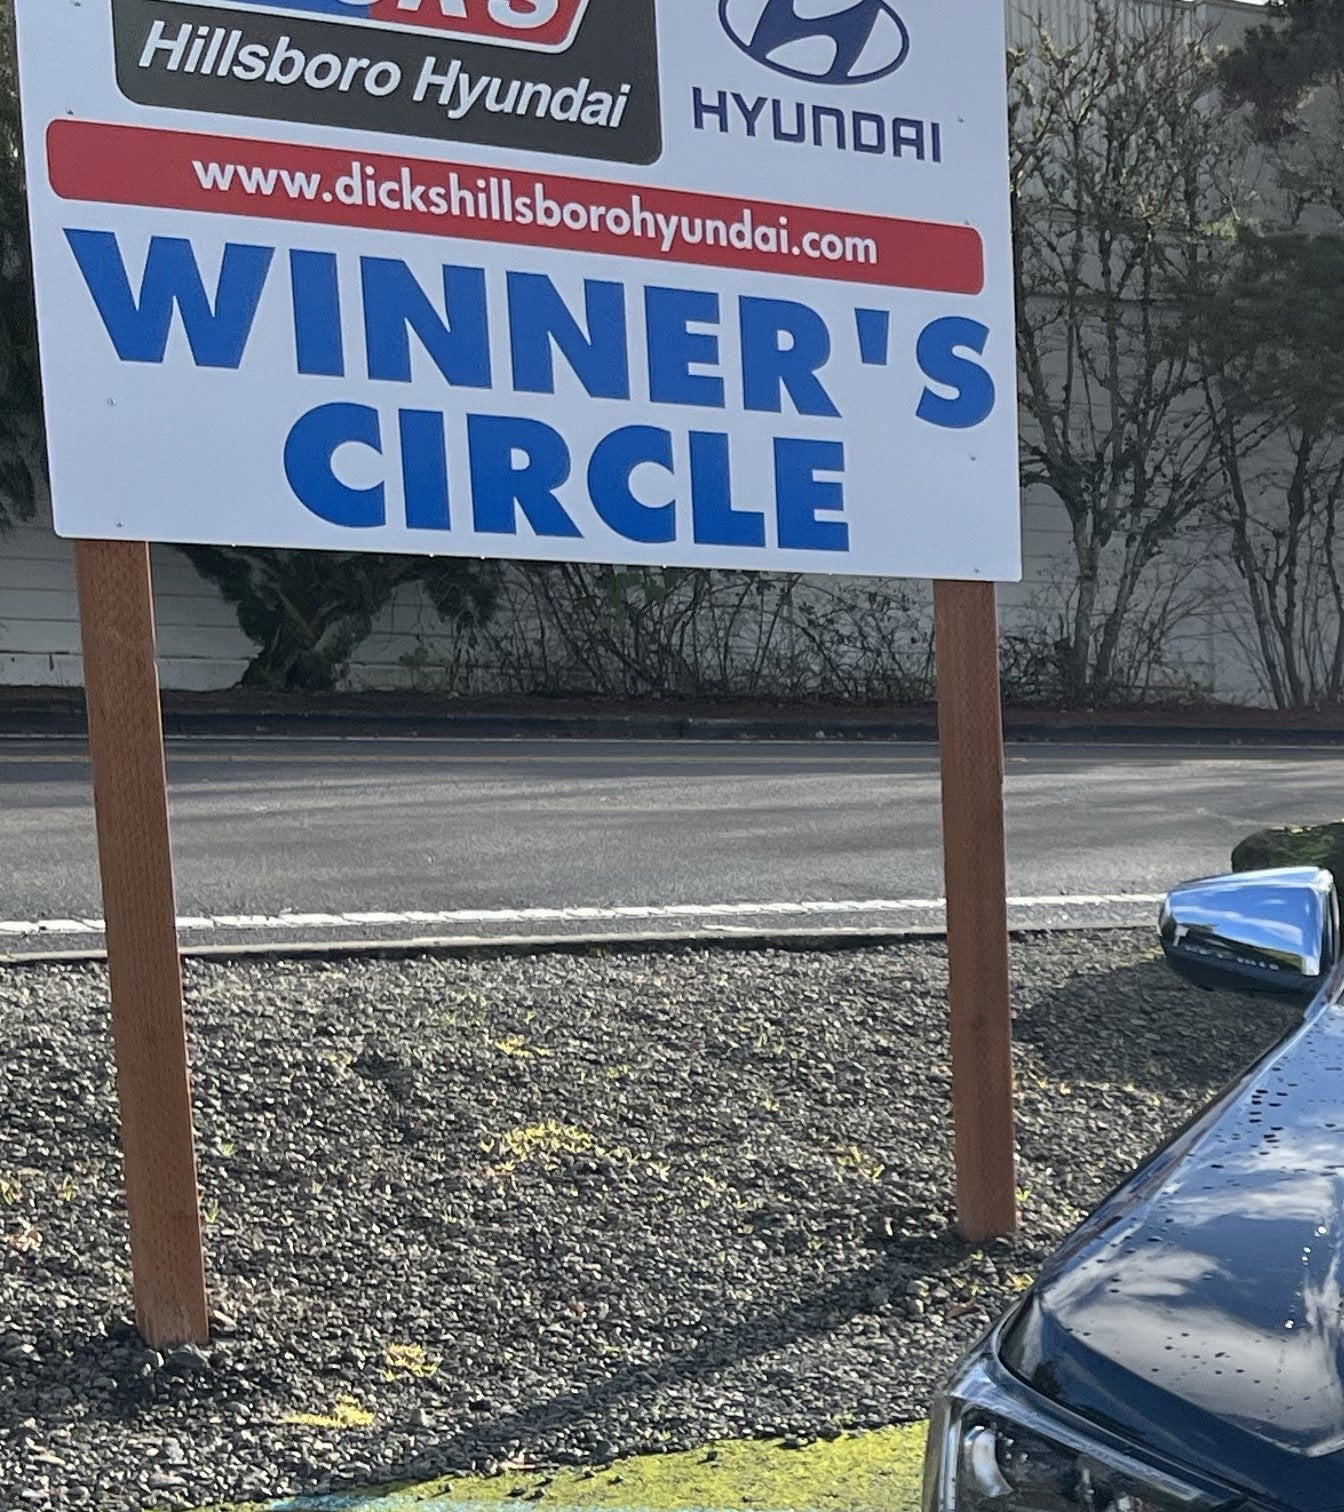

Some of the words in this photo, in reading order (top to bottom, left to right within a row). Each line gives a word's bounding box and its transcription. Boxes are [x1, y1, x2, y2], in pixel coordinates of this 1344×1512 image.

[138, 20, 402, 97] Hillsboro
[412, 56, 632, 129] Hyundai
[692, 86, 942, 163] HYUNDAI
[191, 155, 879, 265] www.dickshillsborohyundai.com
[63, 228, 997, 429] WINNER'S
[282, 401, 850, 552] CIRCLE
